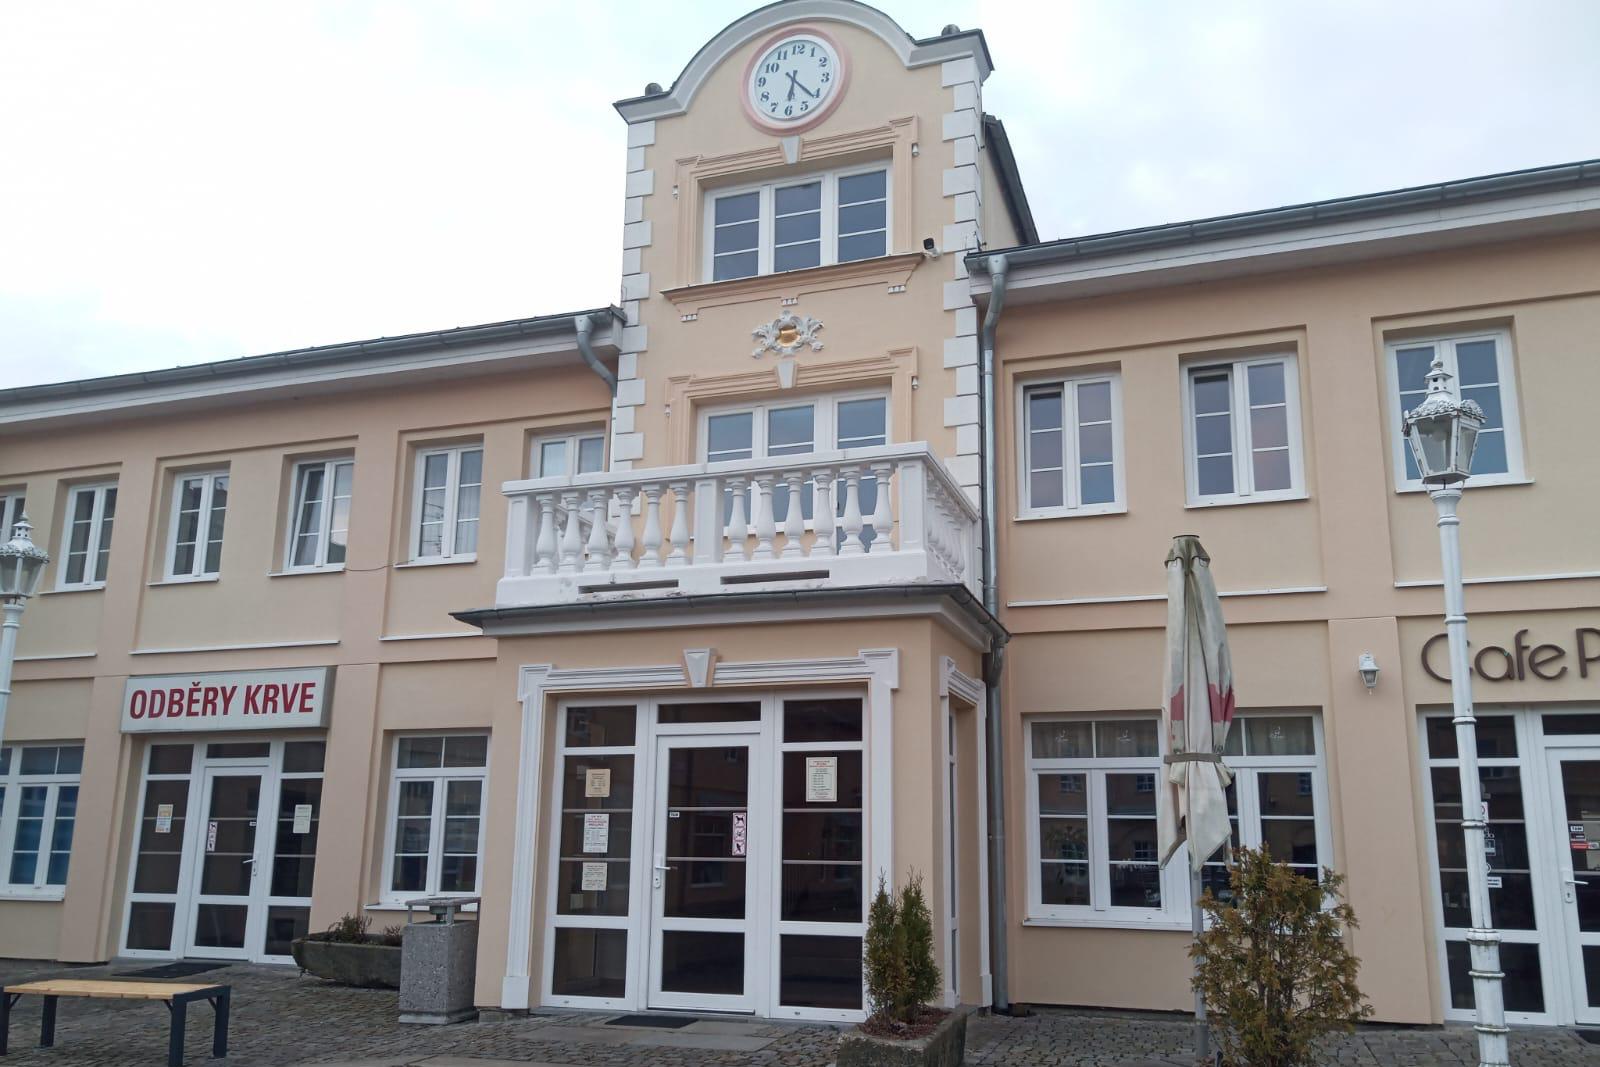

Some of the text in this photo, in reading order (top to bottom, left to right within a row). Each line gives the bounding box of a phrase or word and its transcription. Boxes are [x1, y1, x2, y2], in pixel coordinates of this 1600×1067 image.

[777, 50, 788, 60] 11
[792, 44, 805, 55] 12
[810, 47, 815, 57] 1
[819, 57, 828, 67] 2
[765, 63, 780, 73] 10
[758, 77, 767, 87] 9
[821, 72, 830, 83] 3
[760, 91, 770, 102] 8
[812, 87, 821, 98] 4
[770, 102, 778, 113] 7
[784, 105, 793, 116] 6
[800, 101, 808, 111] 5
[1421, 628, 1568, 683] Cafe
[129, 681, 316, 719] ODBĚRY KRVE
